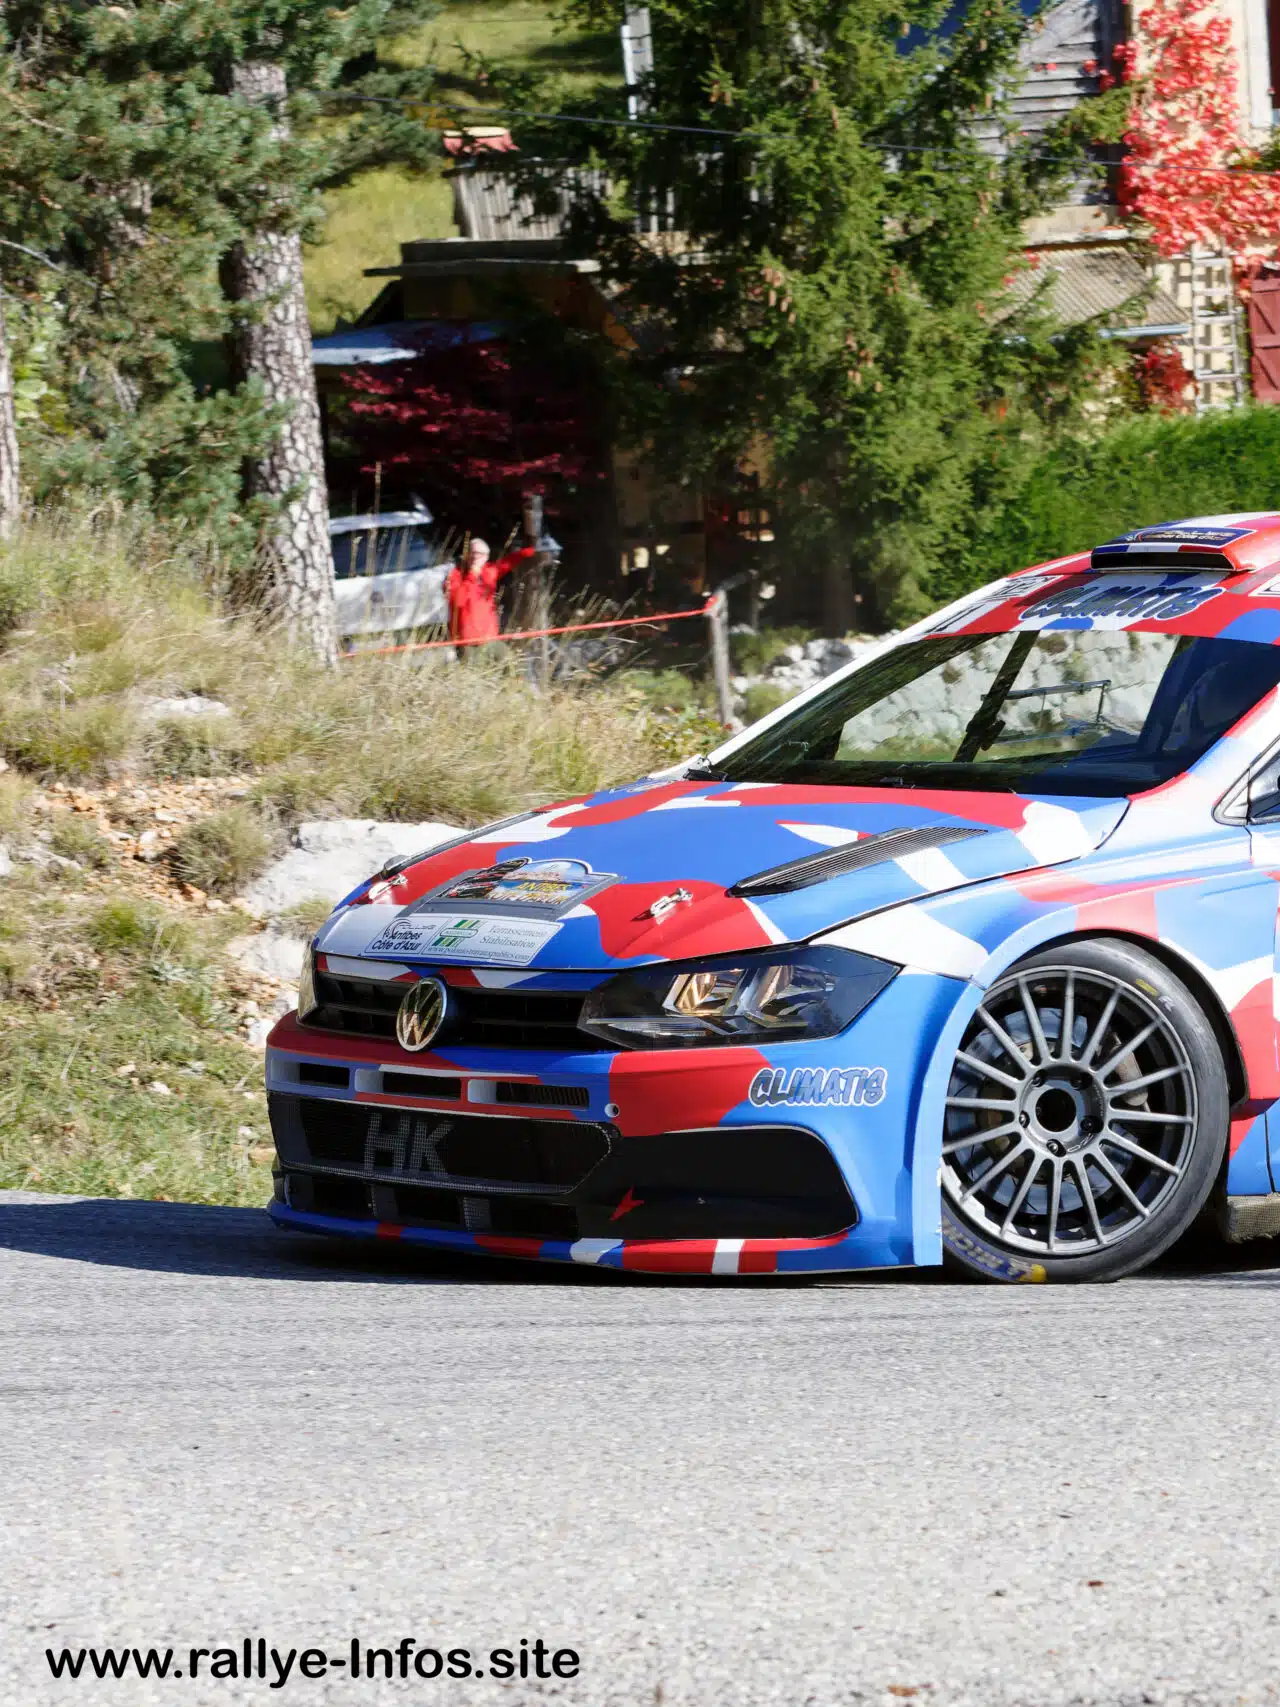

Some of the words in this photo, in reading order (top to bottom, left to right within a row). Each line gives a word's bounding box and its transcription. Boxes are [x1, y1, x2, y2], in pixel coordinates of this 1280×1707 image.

[371, 938, 393, 951] Côte
[394, 940, 421, 952] d'Azur
[748, 1067, 888, 1107] CLIMATIS
[364, 1112, 454, 1179] HK
